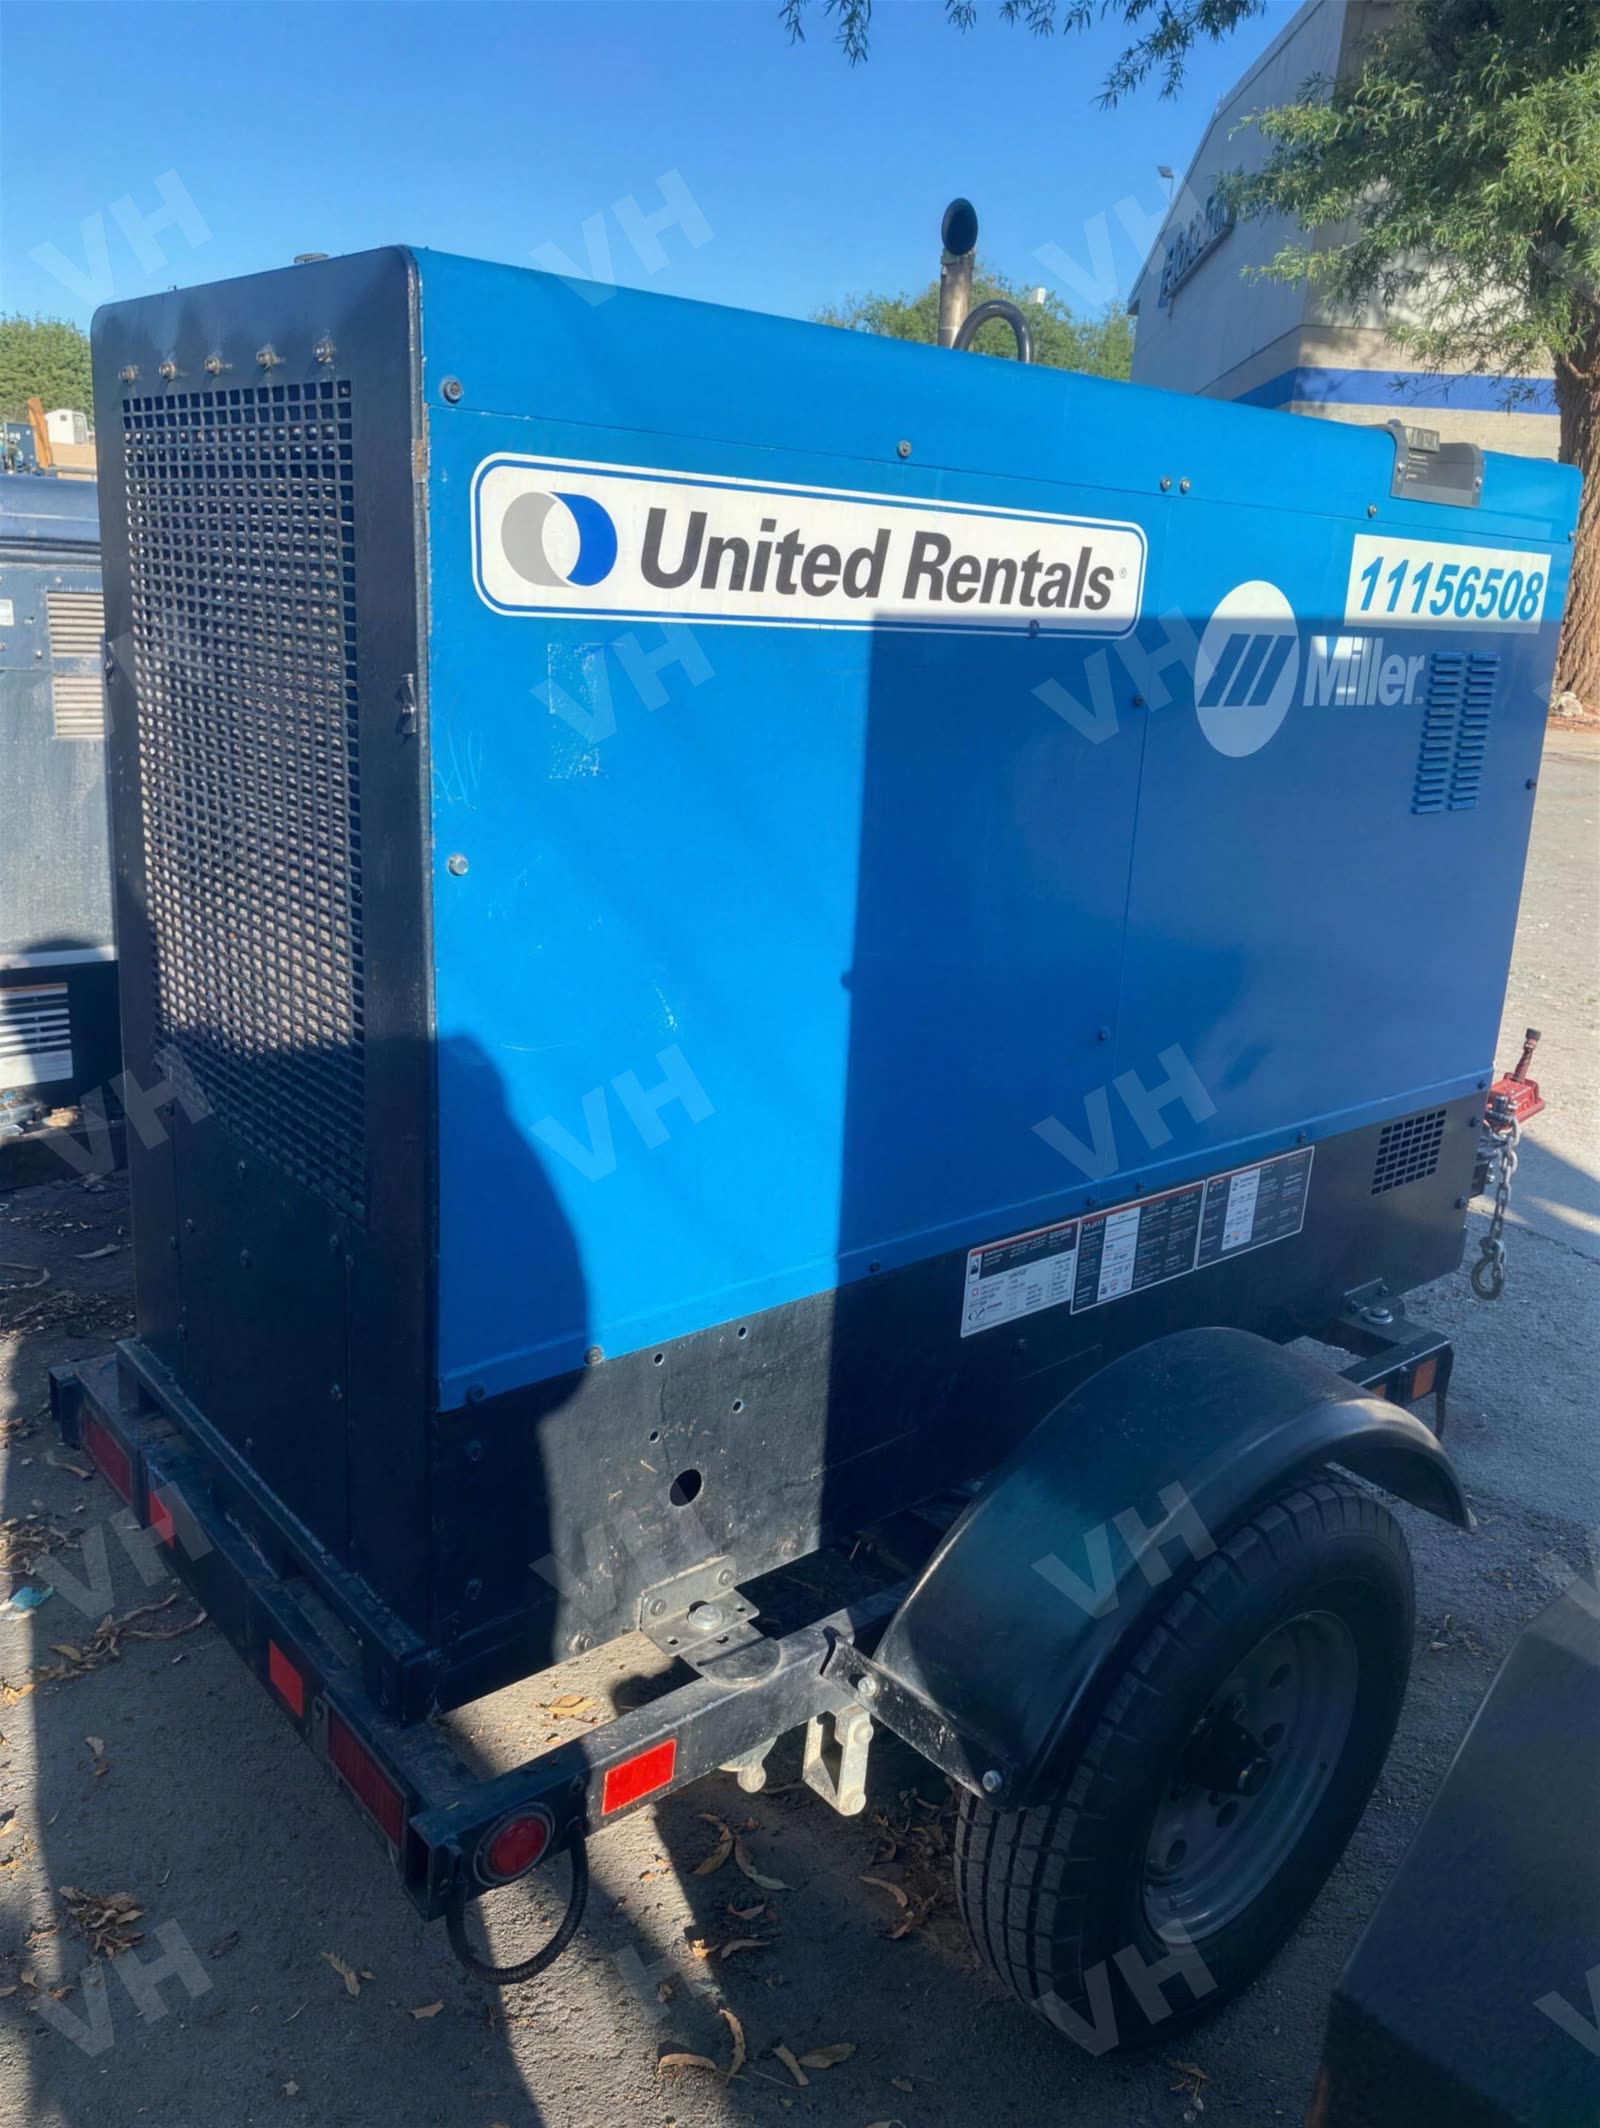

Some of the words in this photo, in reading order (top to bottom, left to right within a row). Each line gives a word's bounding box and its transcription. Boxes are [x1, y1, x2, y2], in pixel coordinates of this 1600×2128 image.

[641, 507, 892, 599] United
[902, 530, 1115, 611] Rentals
[1360, 555, 1545, 621] 11156508
[1303, 635, 1425, 706] Miller
